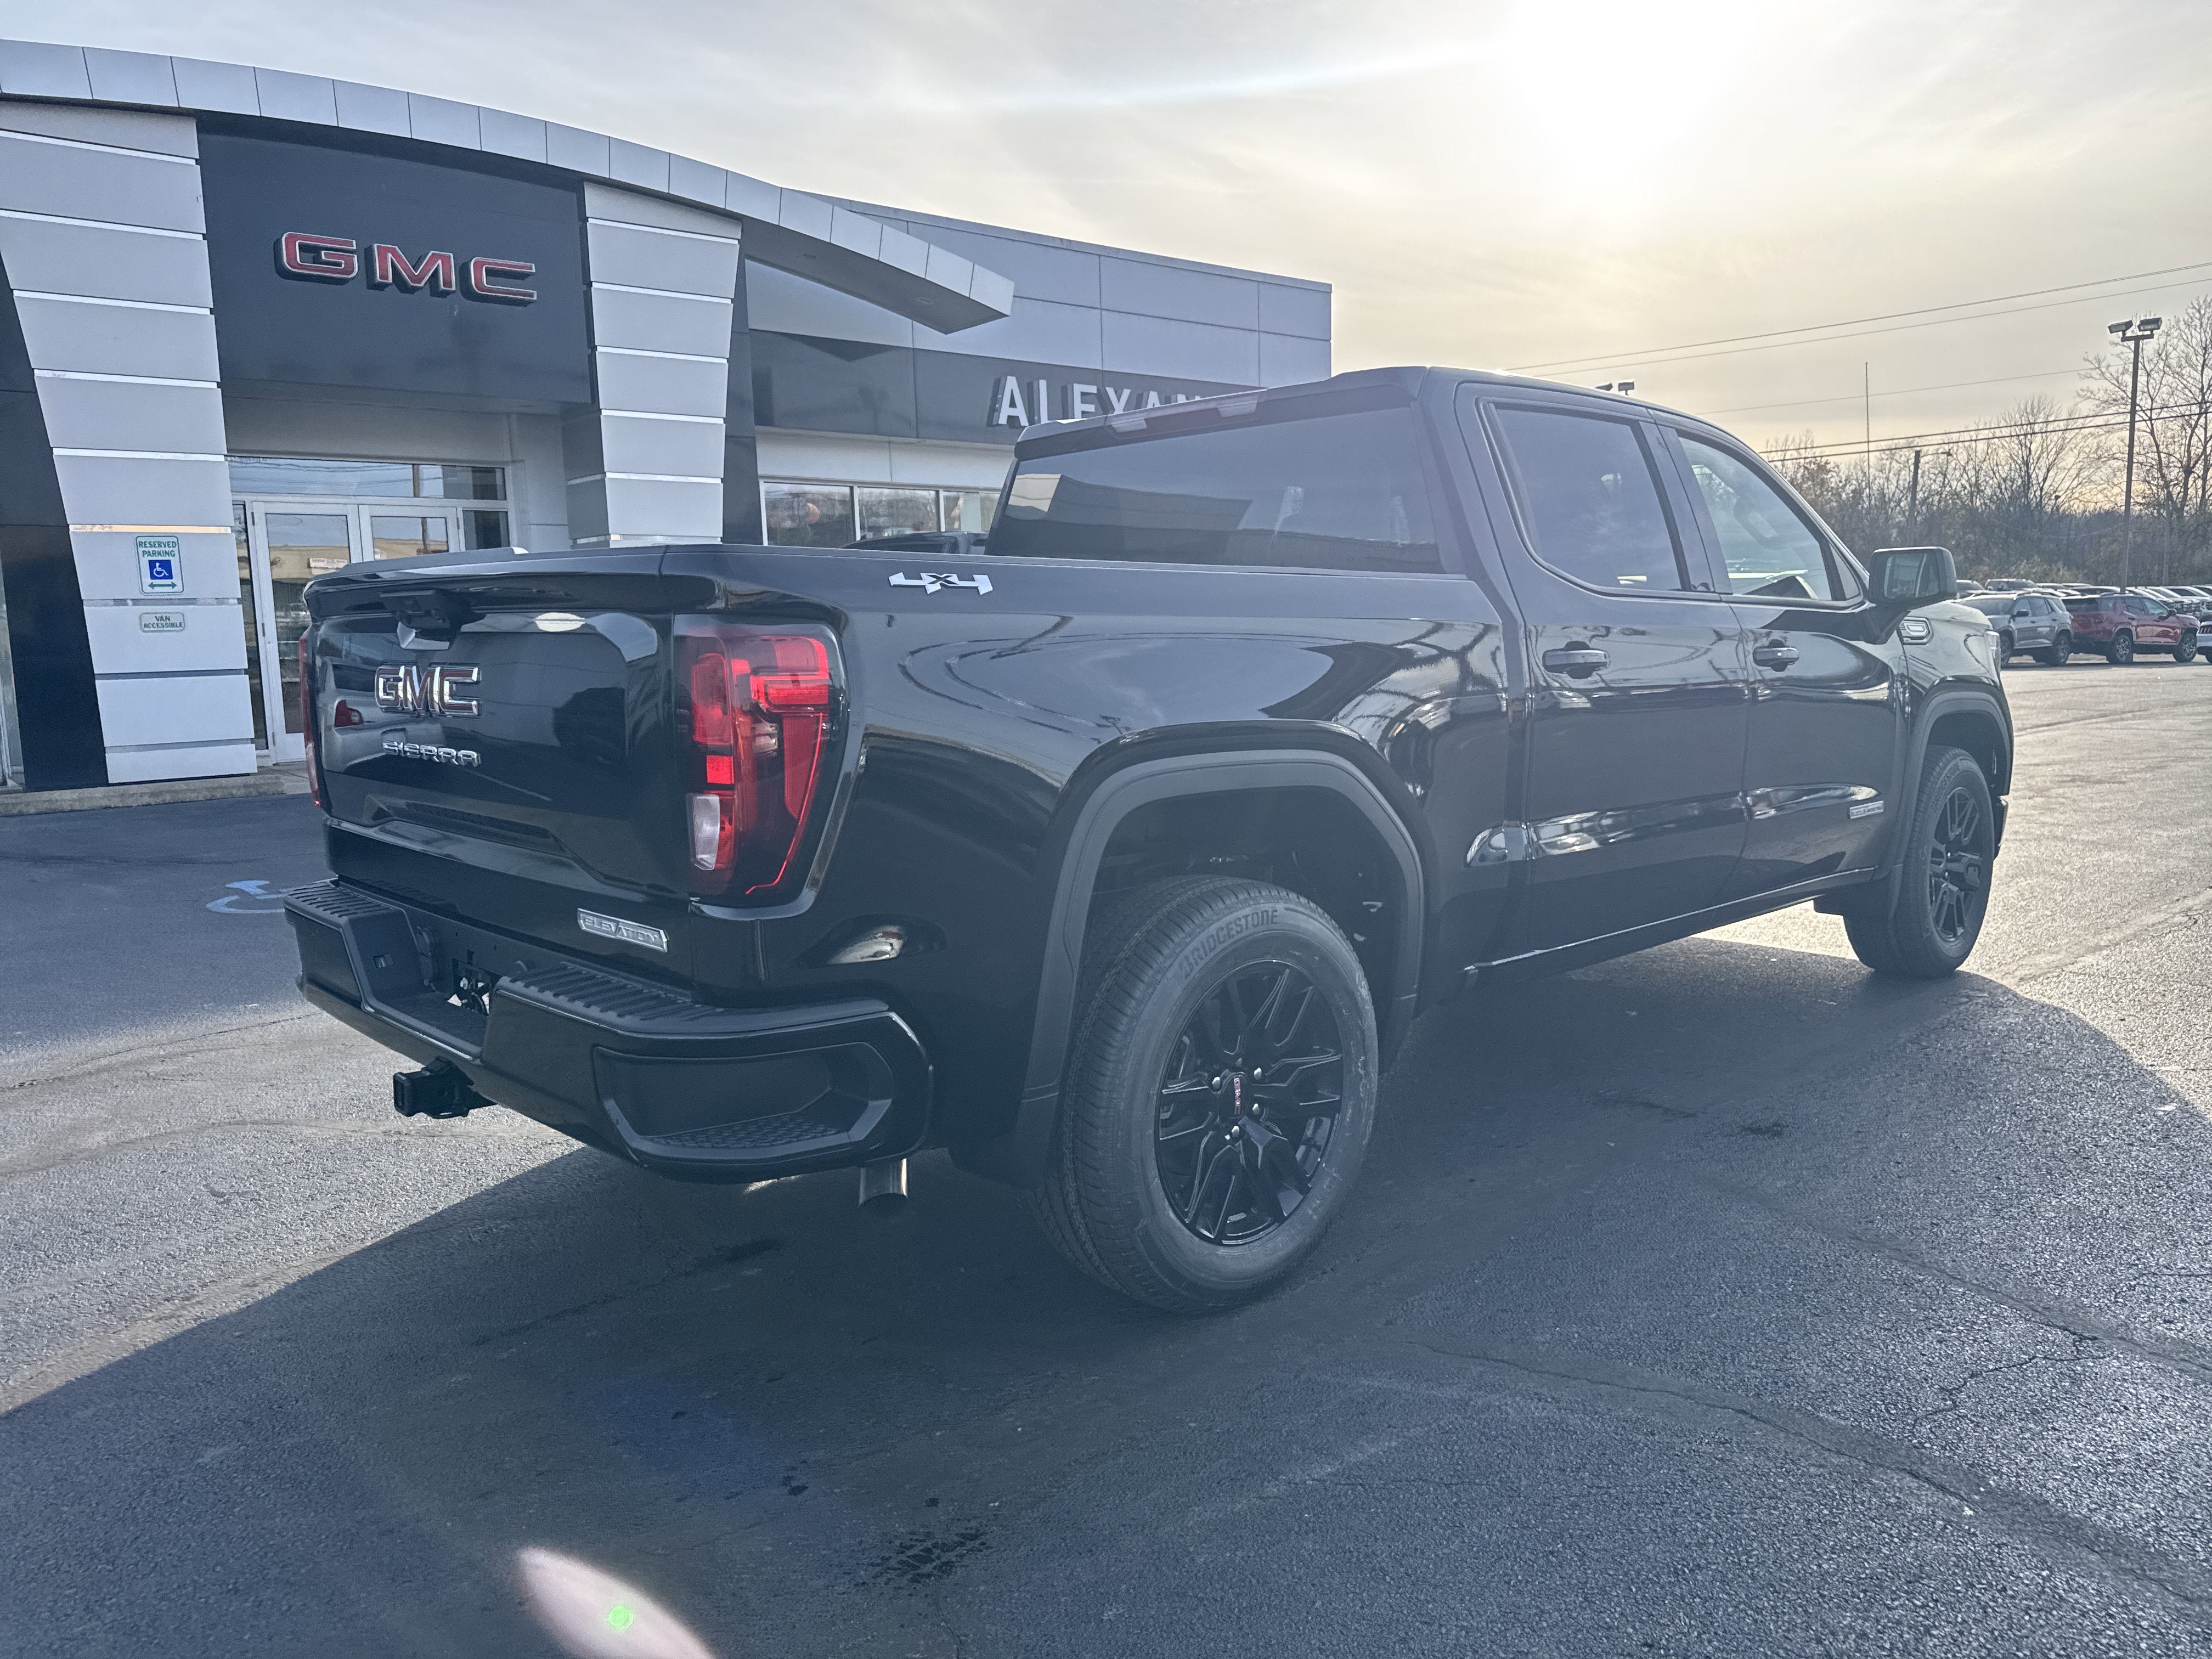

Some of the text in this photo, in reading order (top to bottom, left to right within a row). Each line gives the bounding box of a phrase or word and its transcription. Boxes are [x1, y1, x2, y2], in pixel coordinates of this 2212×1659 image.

[279, 232, 538, 305] GMC
[992, 375, 1203, 427] ALEX
[375, 661, 483, 717] GMC
[382, 741, 482, 768] SIERRA
[583, 915, 663, 946] ELEVATION
[1180, 909, 1278, 980] BRIDGESTONE
